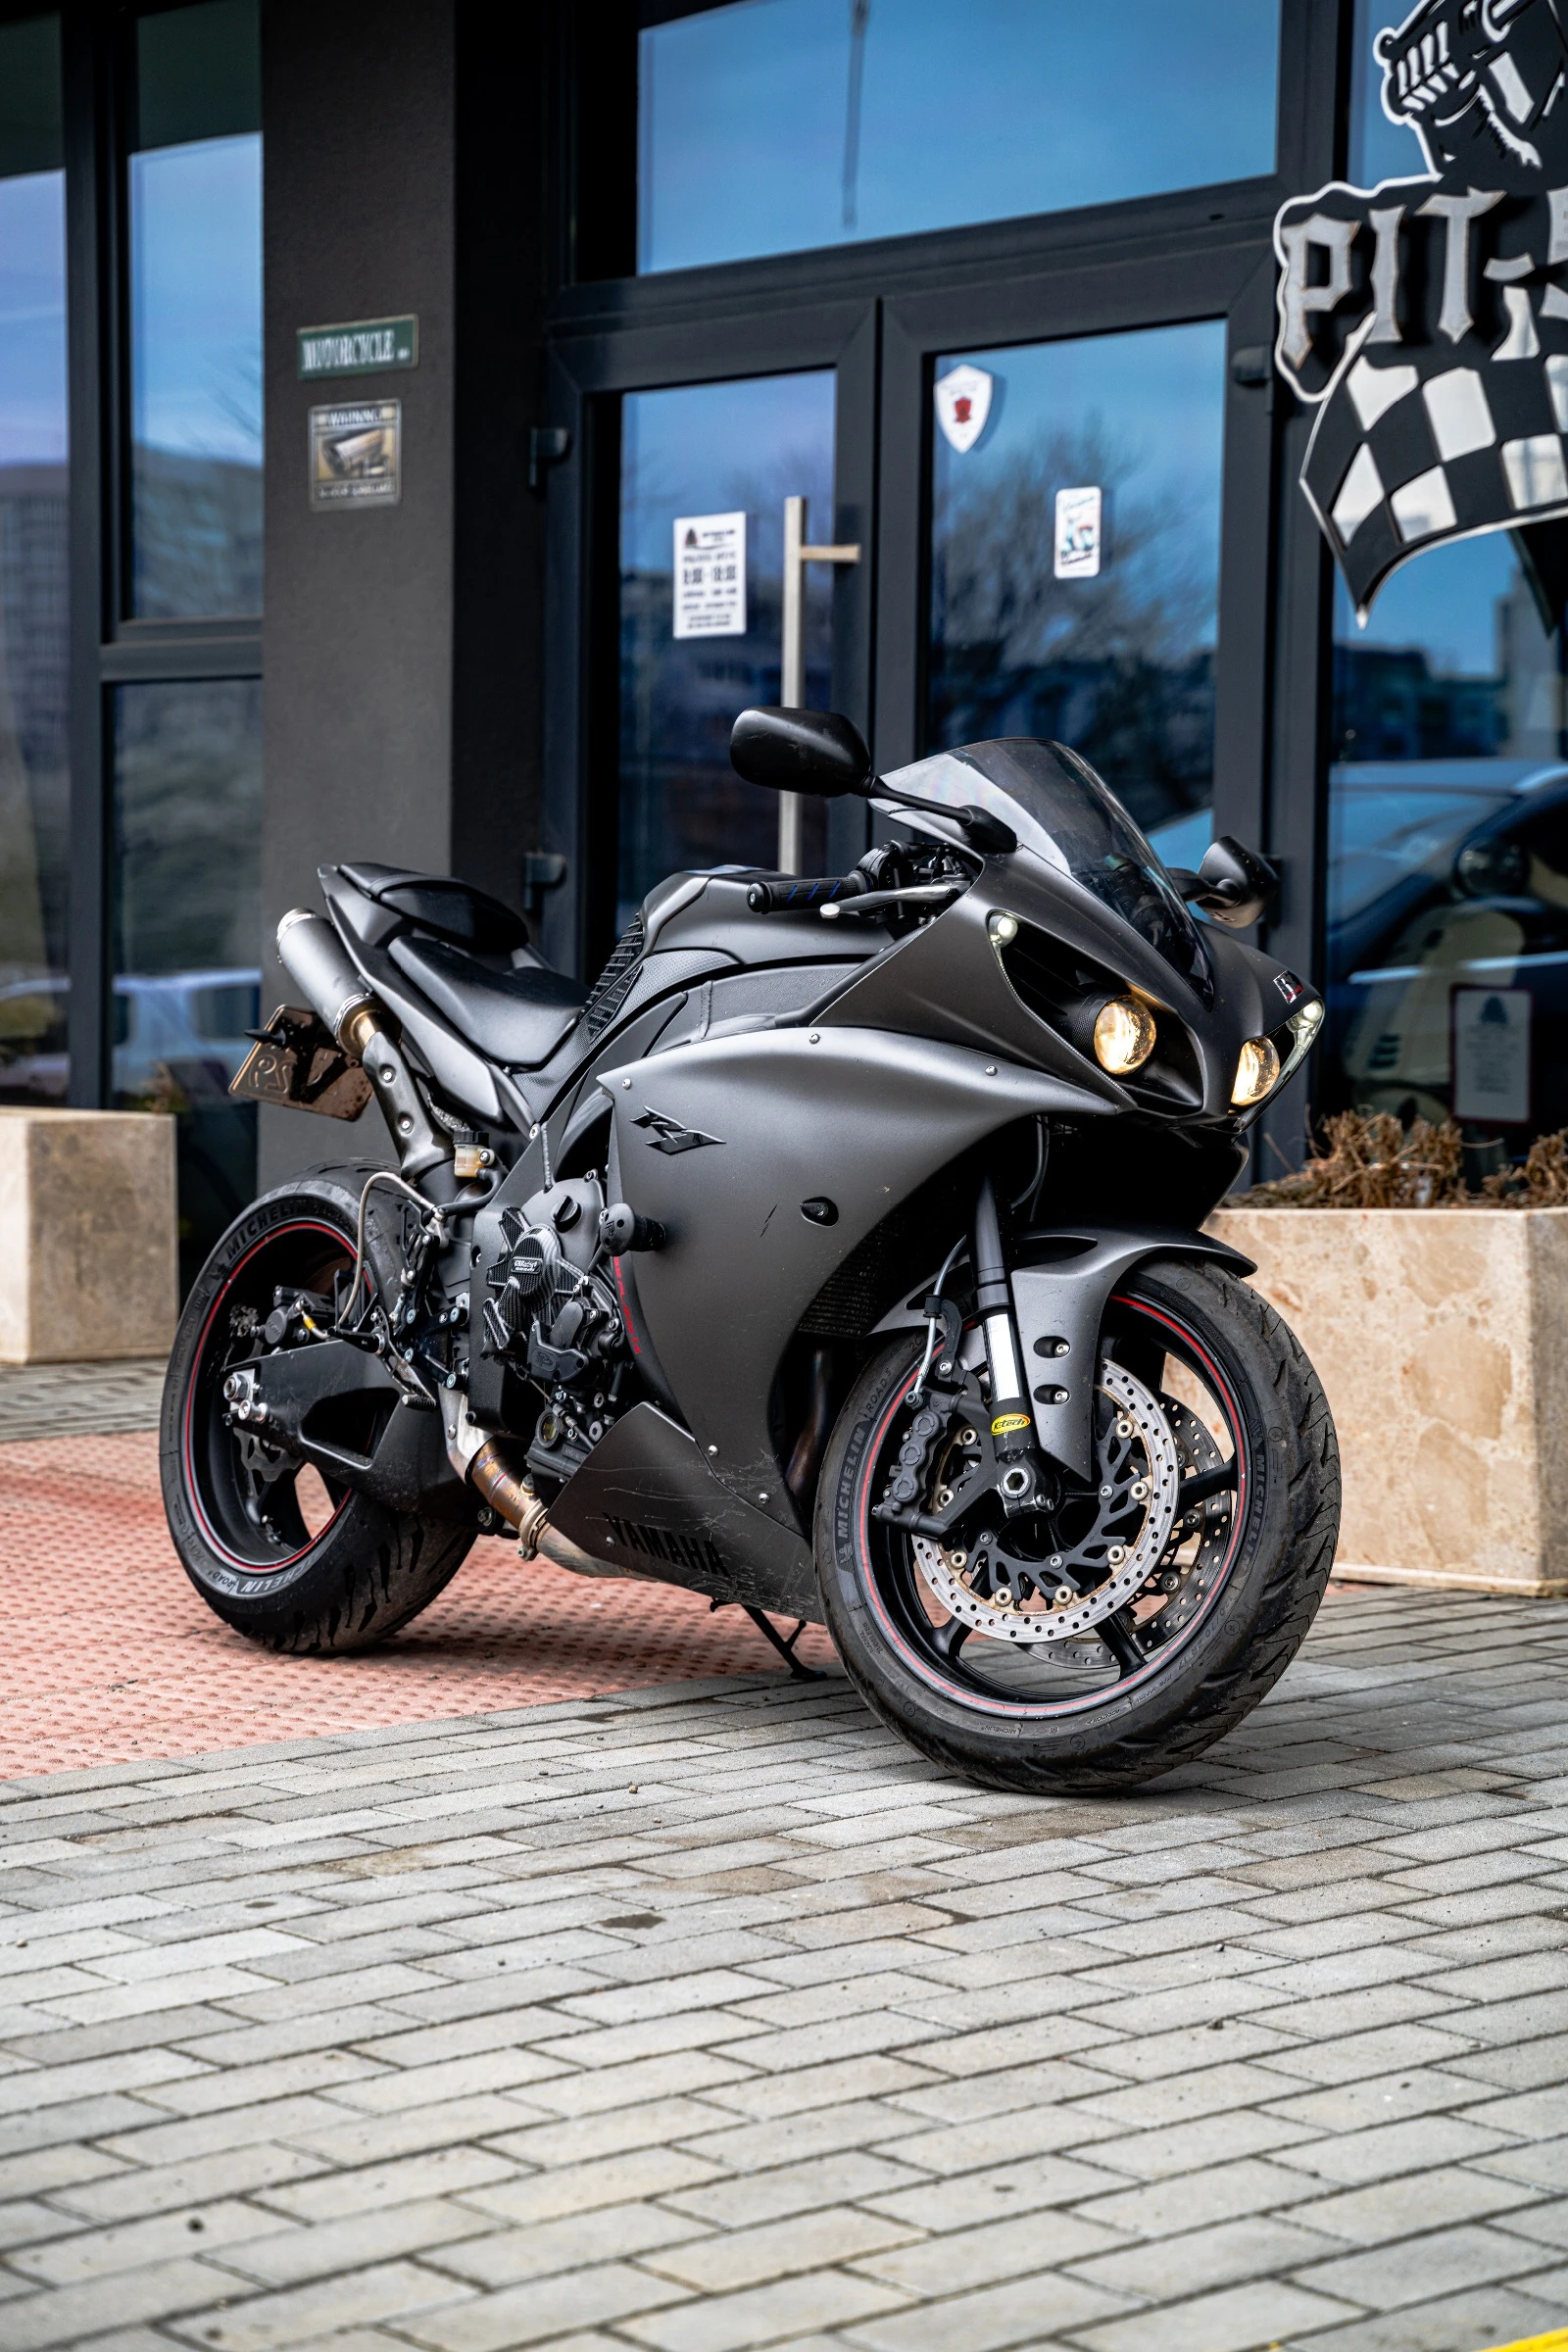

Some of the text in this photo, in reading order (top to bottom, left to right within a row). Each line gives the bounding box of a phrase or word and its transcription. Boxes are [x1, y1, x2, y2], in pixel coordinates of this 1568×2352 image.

[226, 1199, 308, 1259] MICHELIN
[865, 1378, 890, 1413] ROAD
[836, 1426, 866, 1540] MICHELIN
[603, 1512, 731, 1578] YAMAHA
[212, 1570, 236, 1588] ROAD
